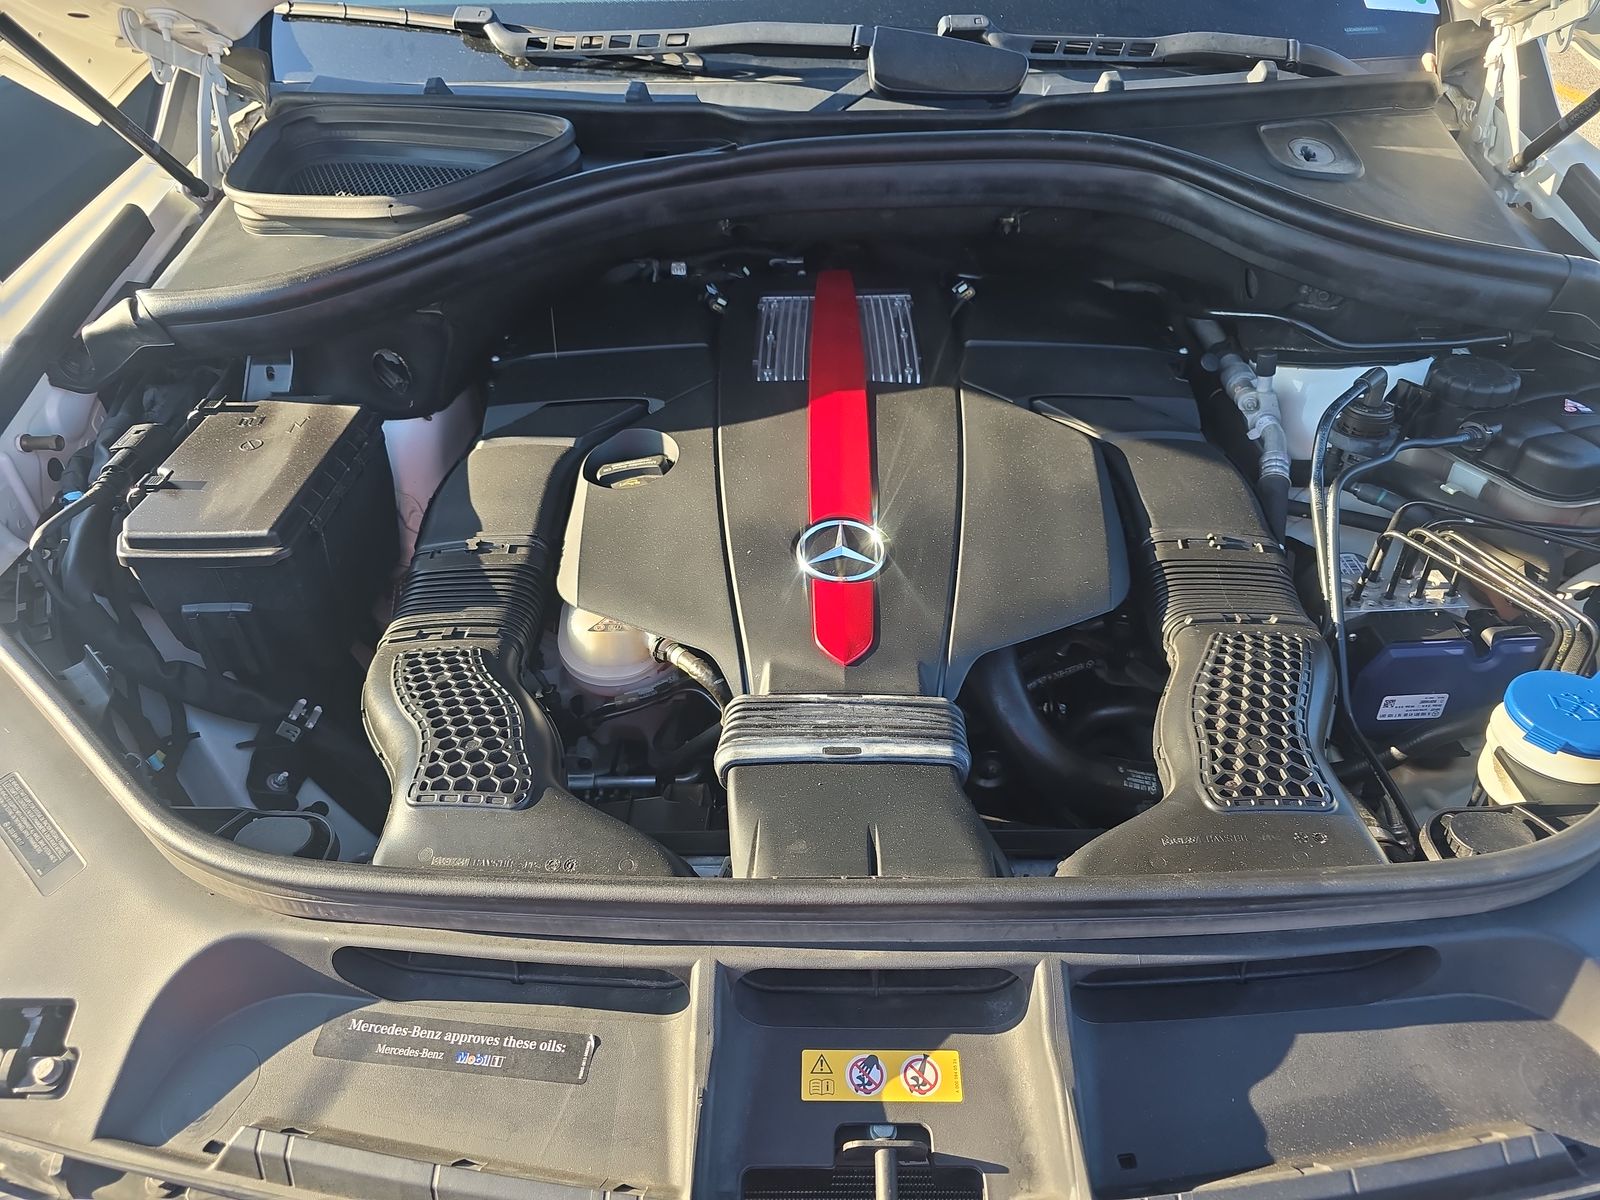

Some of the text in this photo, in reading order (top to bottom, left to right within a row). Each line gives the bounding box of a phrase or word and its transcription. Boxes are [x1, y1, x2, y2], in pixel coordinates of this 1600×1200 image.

[348, 1018, 567, 1053] Mercedes-Benz approves these oils:
[375, 1043, 445, 1060] Mercedes-Benz
[455, 1051, 490, 1067] Mobil
